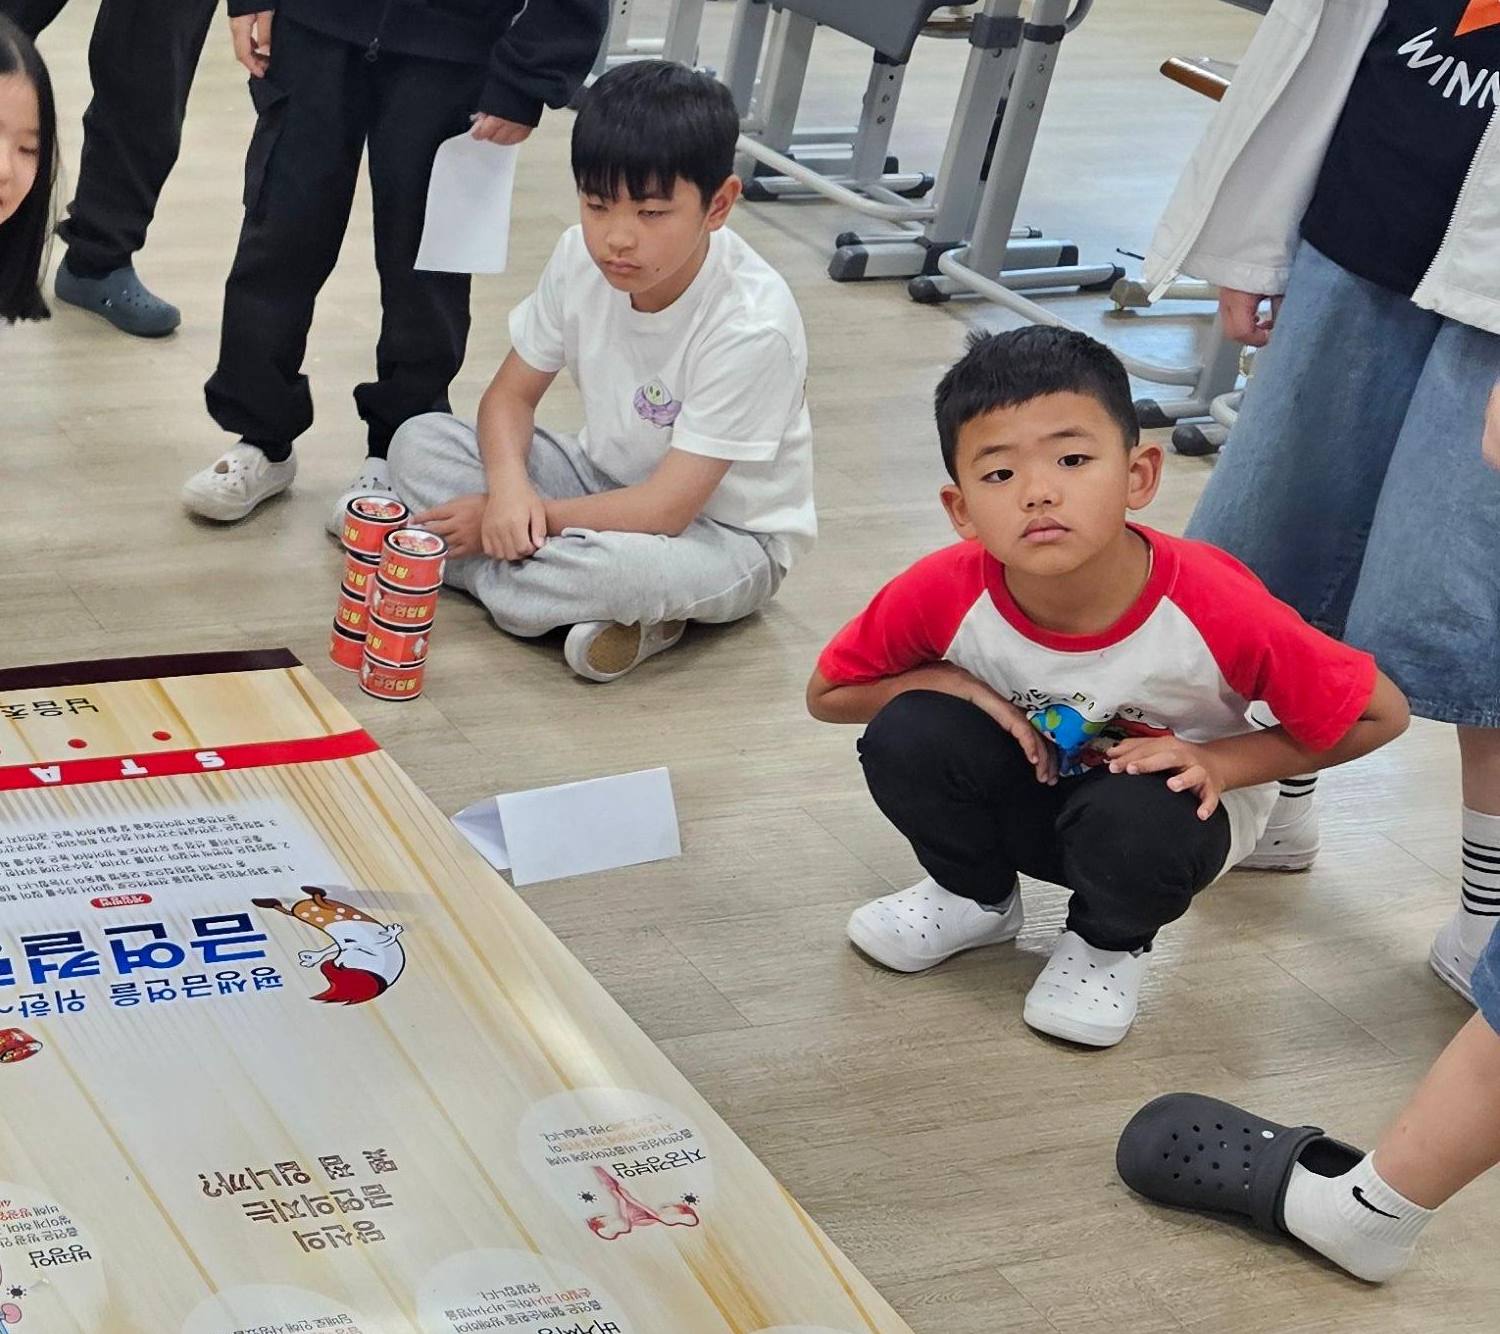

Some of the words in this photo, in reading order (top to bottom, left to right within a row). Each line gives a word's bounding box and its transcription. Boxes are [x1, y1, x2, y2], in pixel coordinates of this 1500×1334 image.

[108, 966, 284, 1009] 평생금연을
[198, 1161, 311, 1198] 입니까?
[318, 1155, 355, 1180] 점
[612, 1148, 706, 1179] 자궁경부암
[242, 1183, 393, 1224] 금연의지는
[292, 1221, 385, 1253] 당신의
[28, 1243, 92, 1268] 방광암
